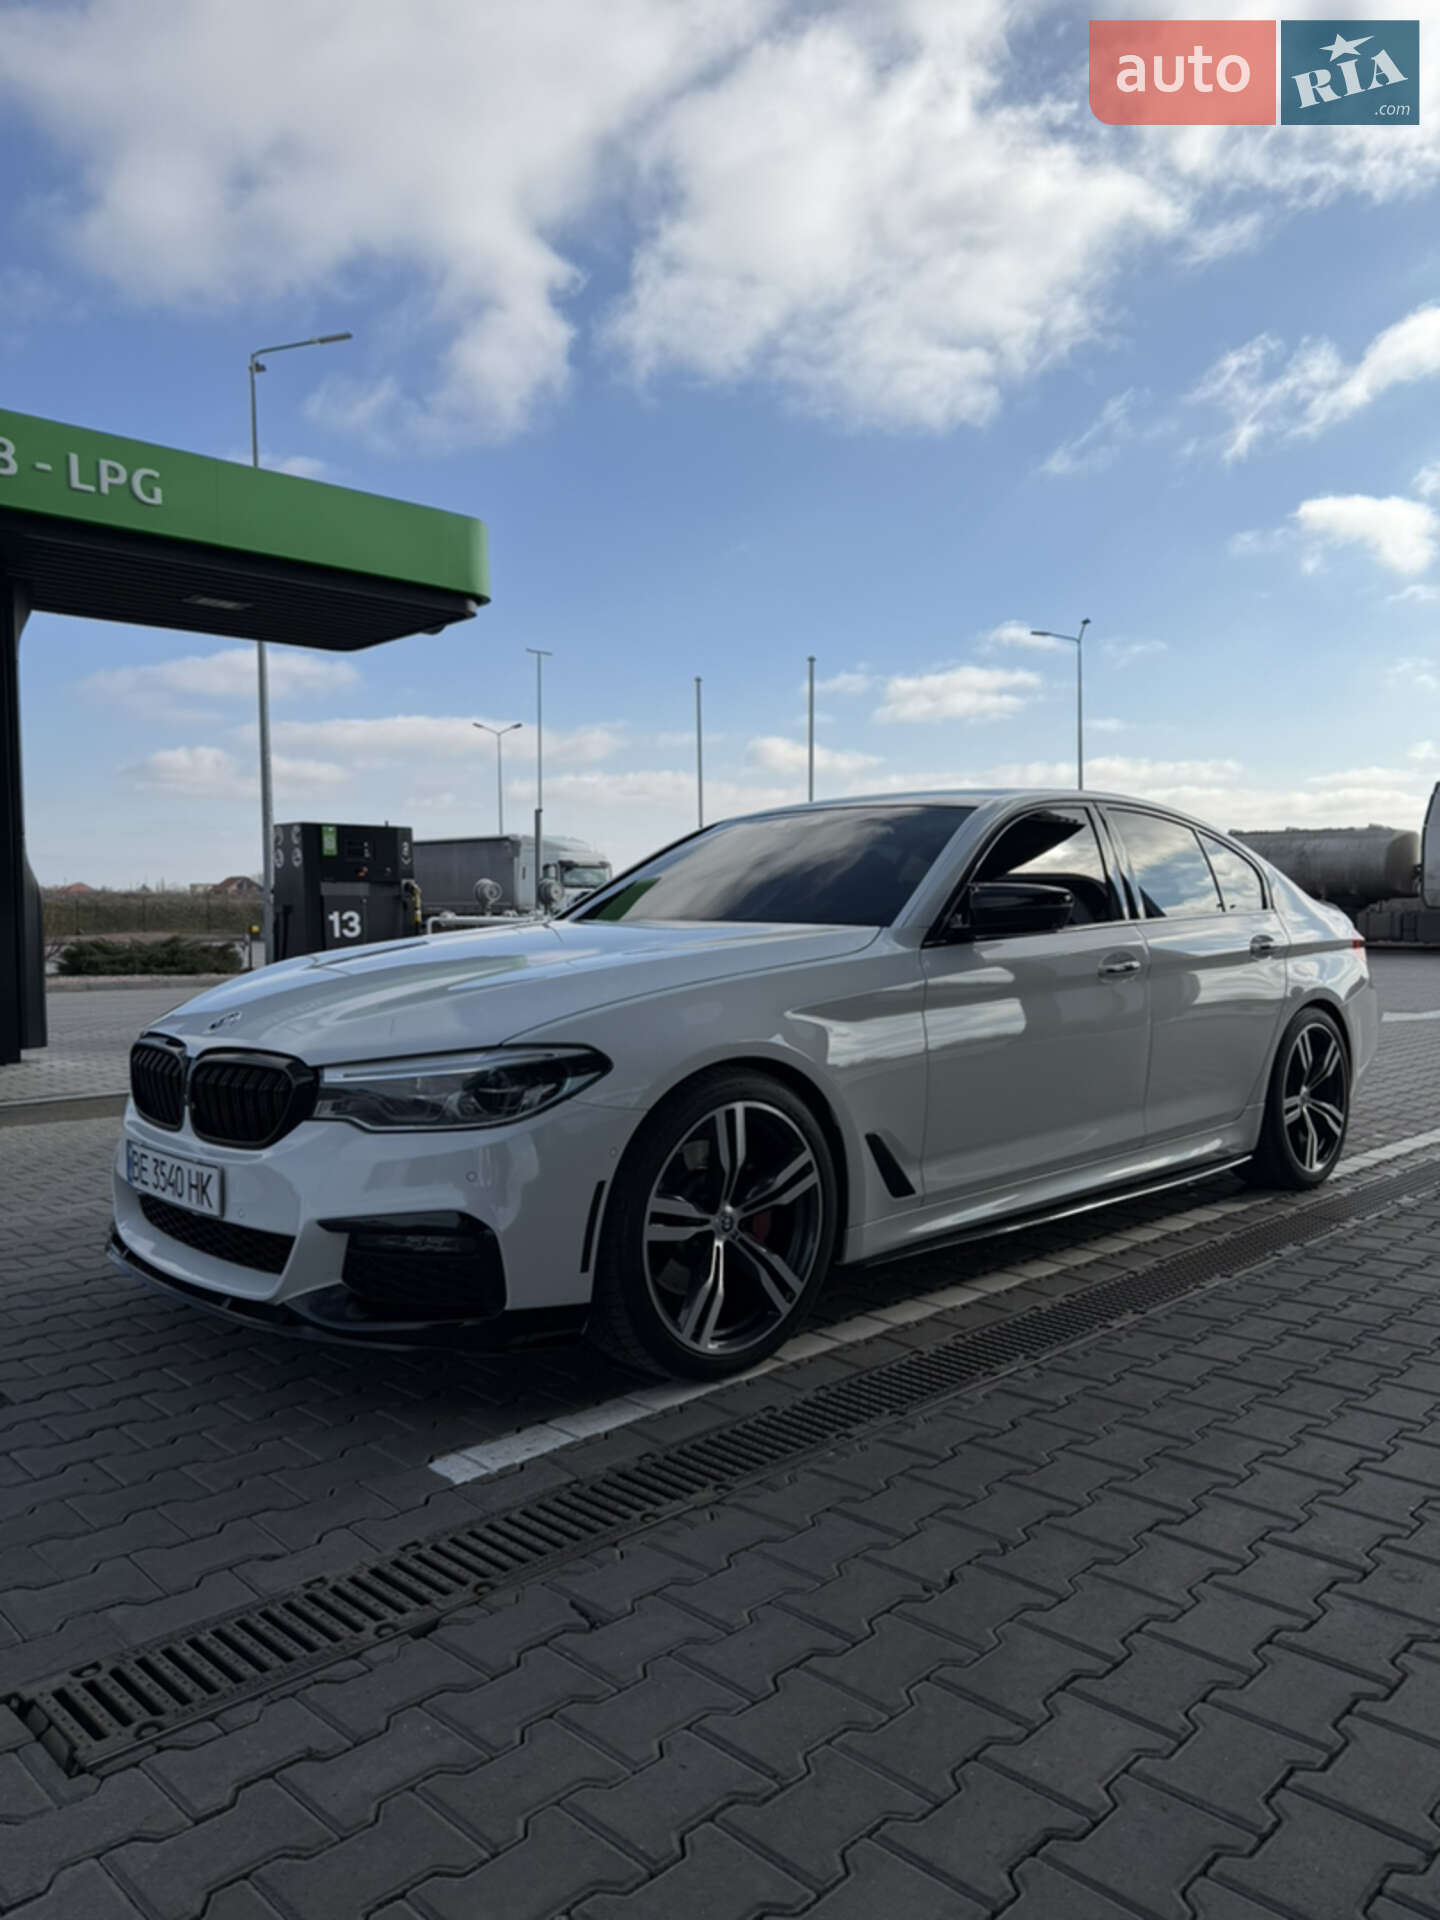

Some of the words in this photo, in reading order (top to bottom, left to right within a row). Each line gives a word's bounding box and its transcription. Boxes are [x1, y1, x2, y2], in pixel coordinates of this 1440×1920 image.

[67, 452, 163, 505] LPG
[328, 911, 361, 938] 13
[152, 1158, 184, 1198] 3540
[188, 1169, 213, 1209] HK
